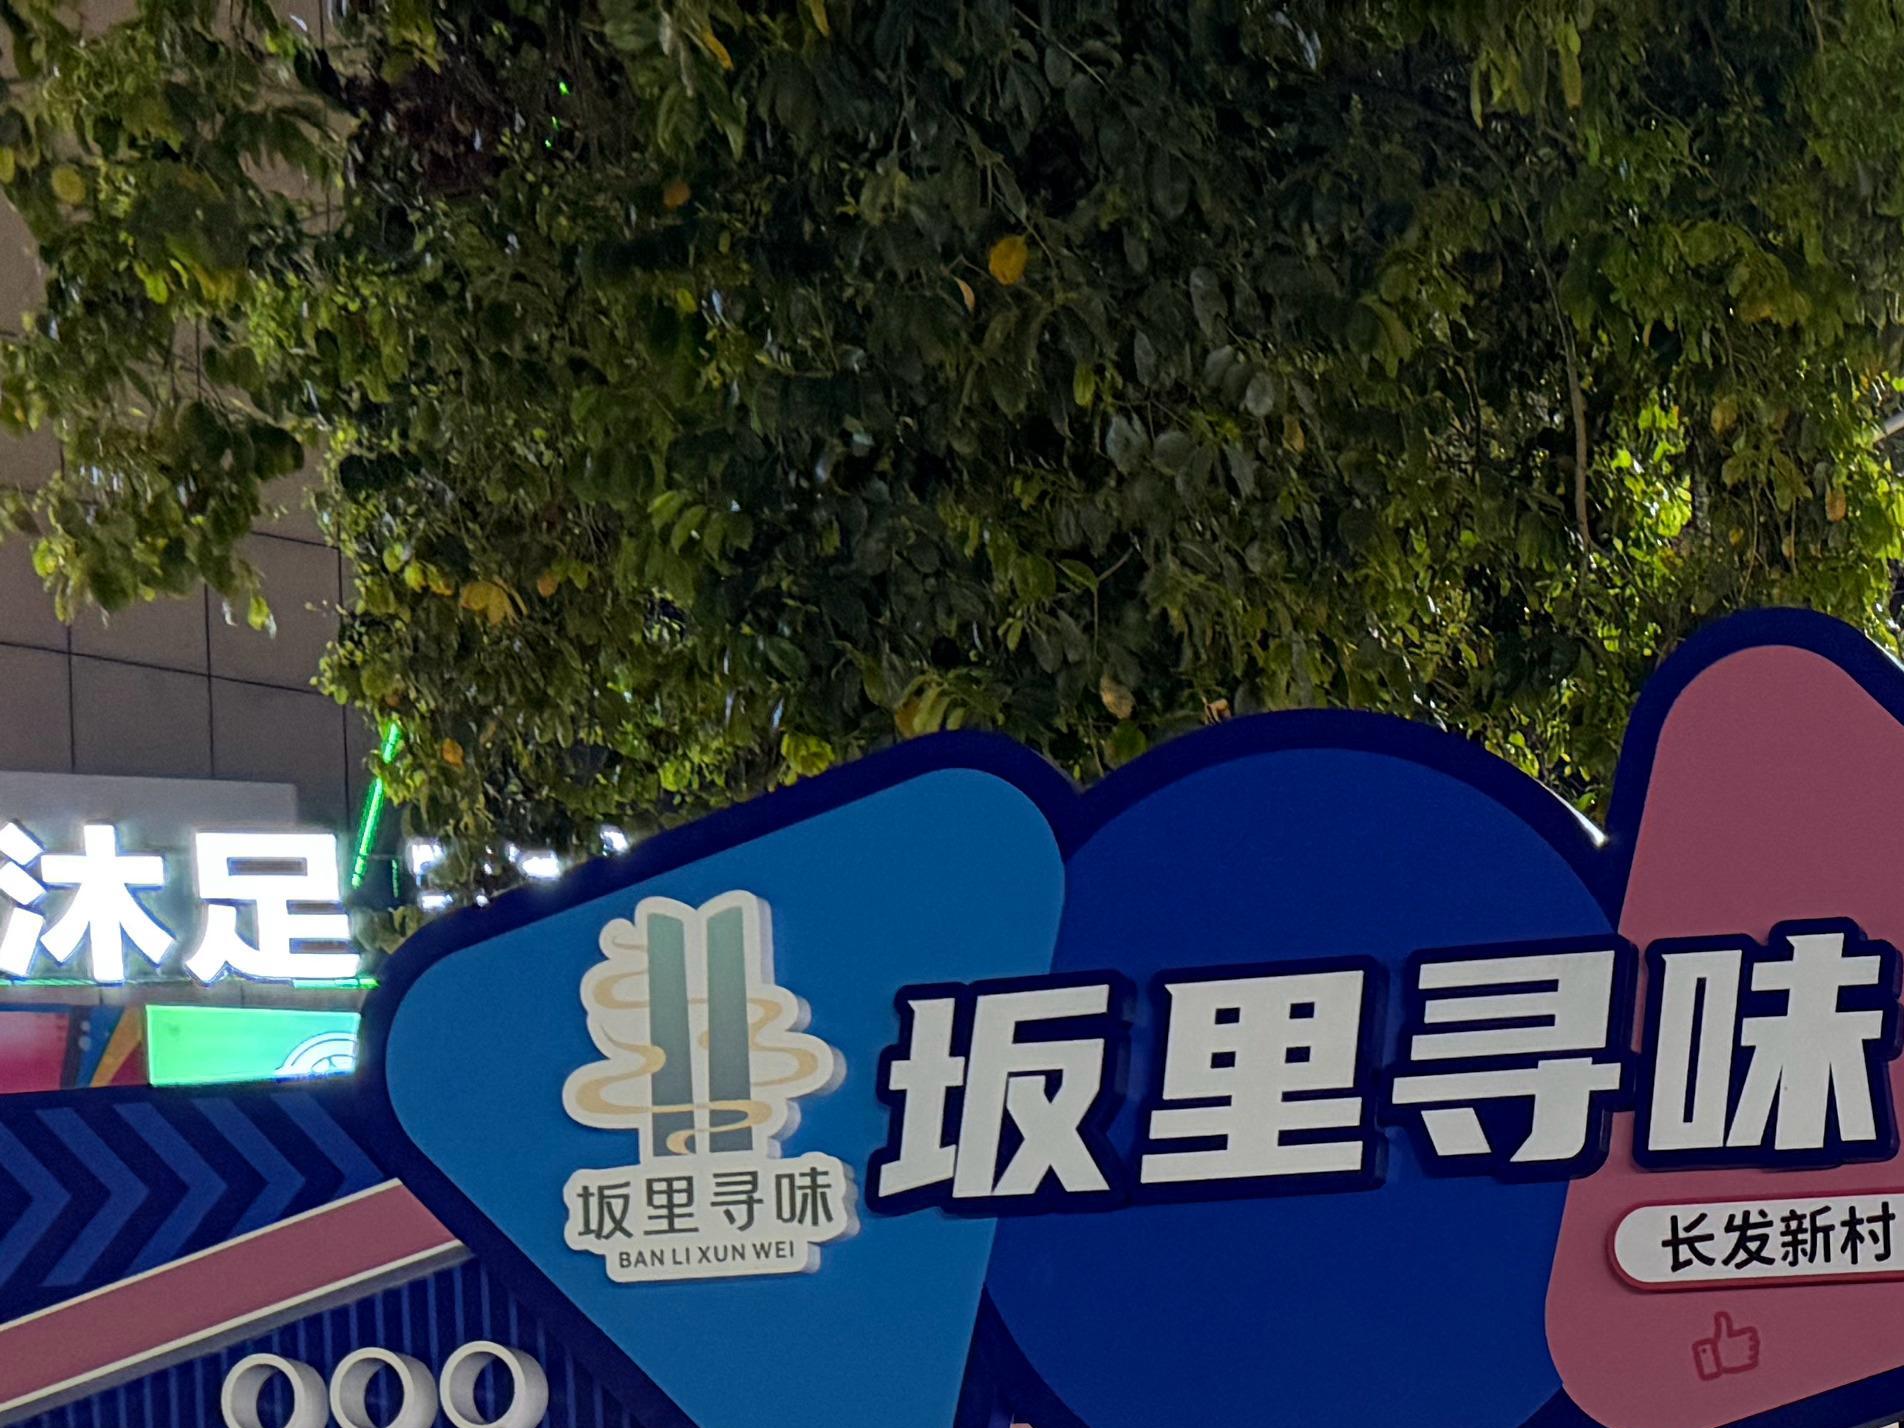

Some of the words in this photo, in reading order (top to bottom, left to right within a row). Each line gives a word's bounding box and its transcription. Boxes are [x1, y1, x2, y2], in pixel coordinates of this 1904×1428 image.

[0, 822, 362, 985] 沐足
[868, 932, 1883, 1198] 坂里寻味
[576, 1164, 834, 1242] 坂里寻味
[1660, 1200, 1898, 1272] 长发新村
[618, 1248, 667, 1269] BAN
[672, 1247, 691, 1267] LI
[697, 1244, 747, 1264] XUN
[752, 1241, 795, 1261] WEI
